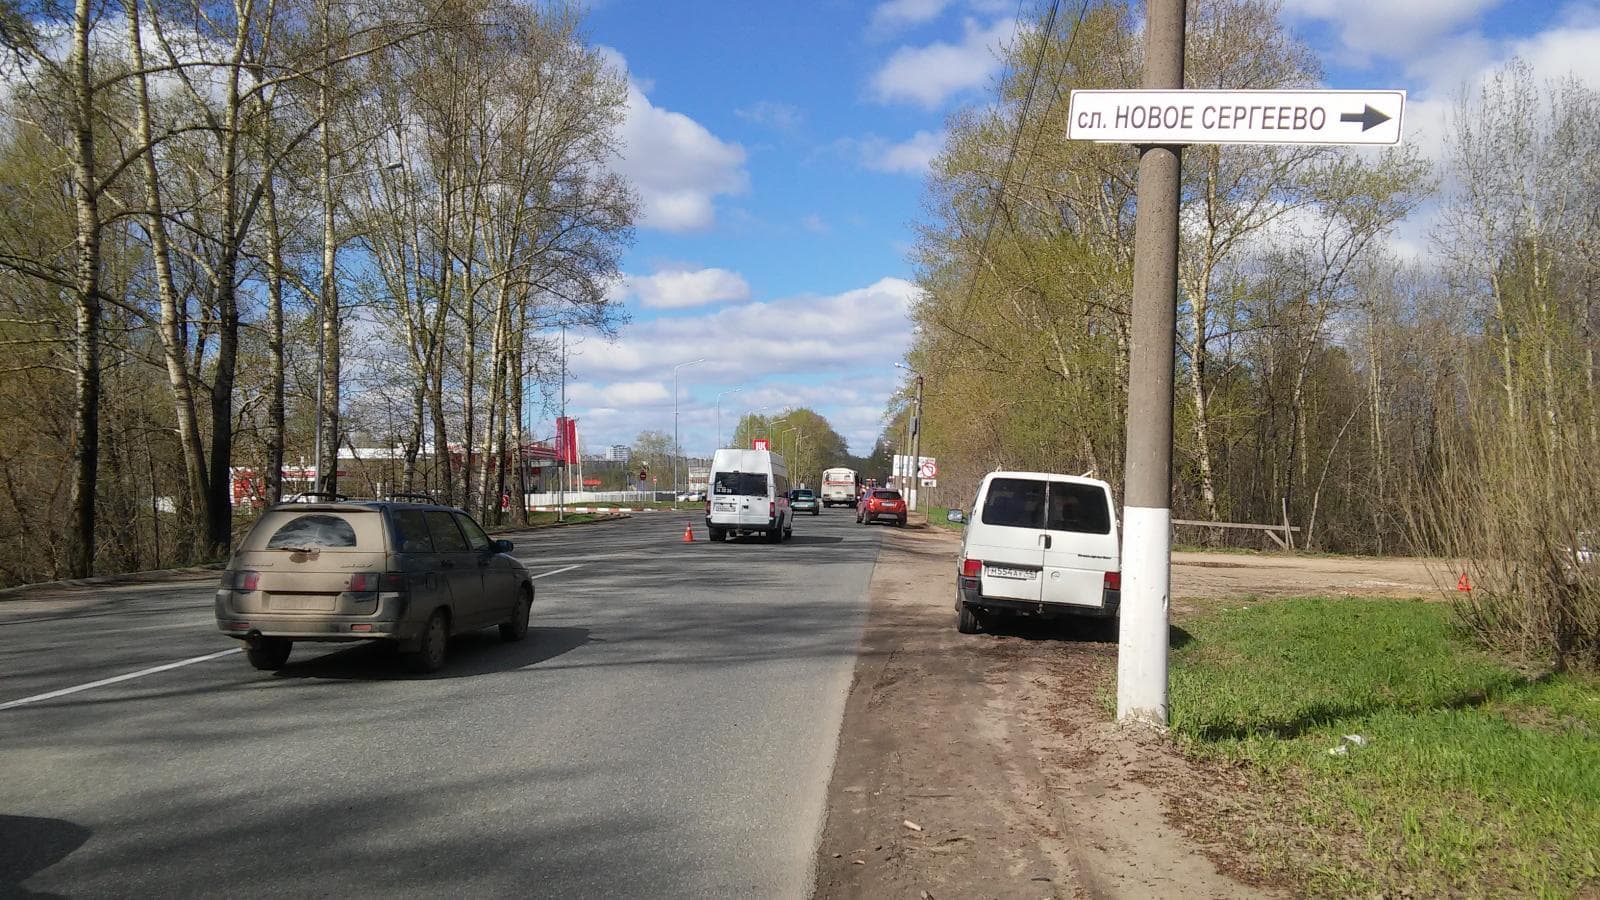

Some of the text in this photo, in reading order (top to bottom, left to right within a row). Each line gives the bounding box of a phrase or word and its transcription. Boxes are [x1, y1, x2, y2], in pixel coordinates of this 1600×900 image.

[1078, 105, 1326, 130] сл. НОВОЕ СЕРГЕЕВО
